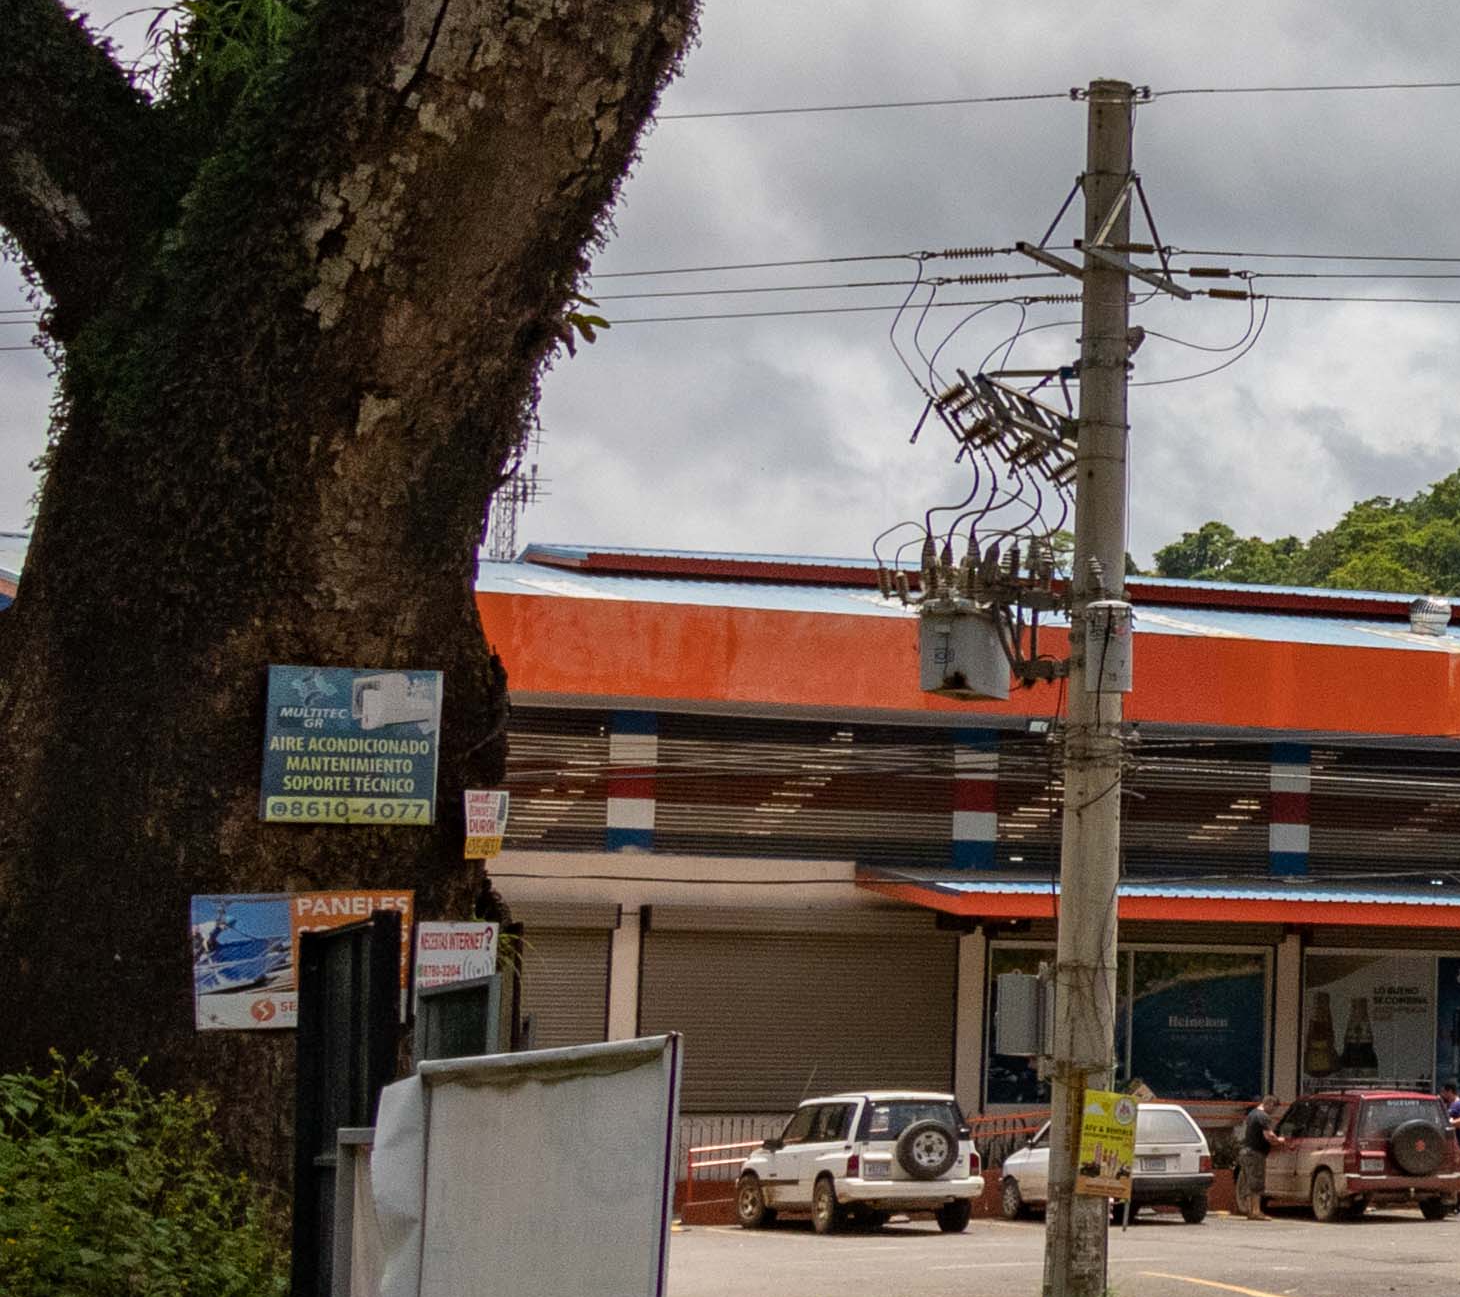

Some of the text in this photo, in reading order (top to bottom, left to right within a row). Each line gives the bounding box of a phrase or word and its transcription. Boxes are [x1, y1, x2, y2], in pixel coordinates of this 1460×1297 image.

[280, 706, 349, 719] MULTITEC
[304, 718, 324, 728] GR
[269, 736, 429, 755] AIRE ACONDICIONADO
[286, 756, 413, 773] MANTENIMIENTO
[283, 775, 415, 792] SOPORTE TÉCNICO
[290, 802, 425, 819] 8610-4077
